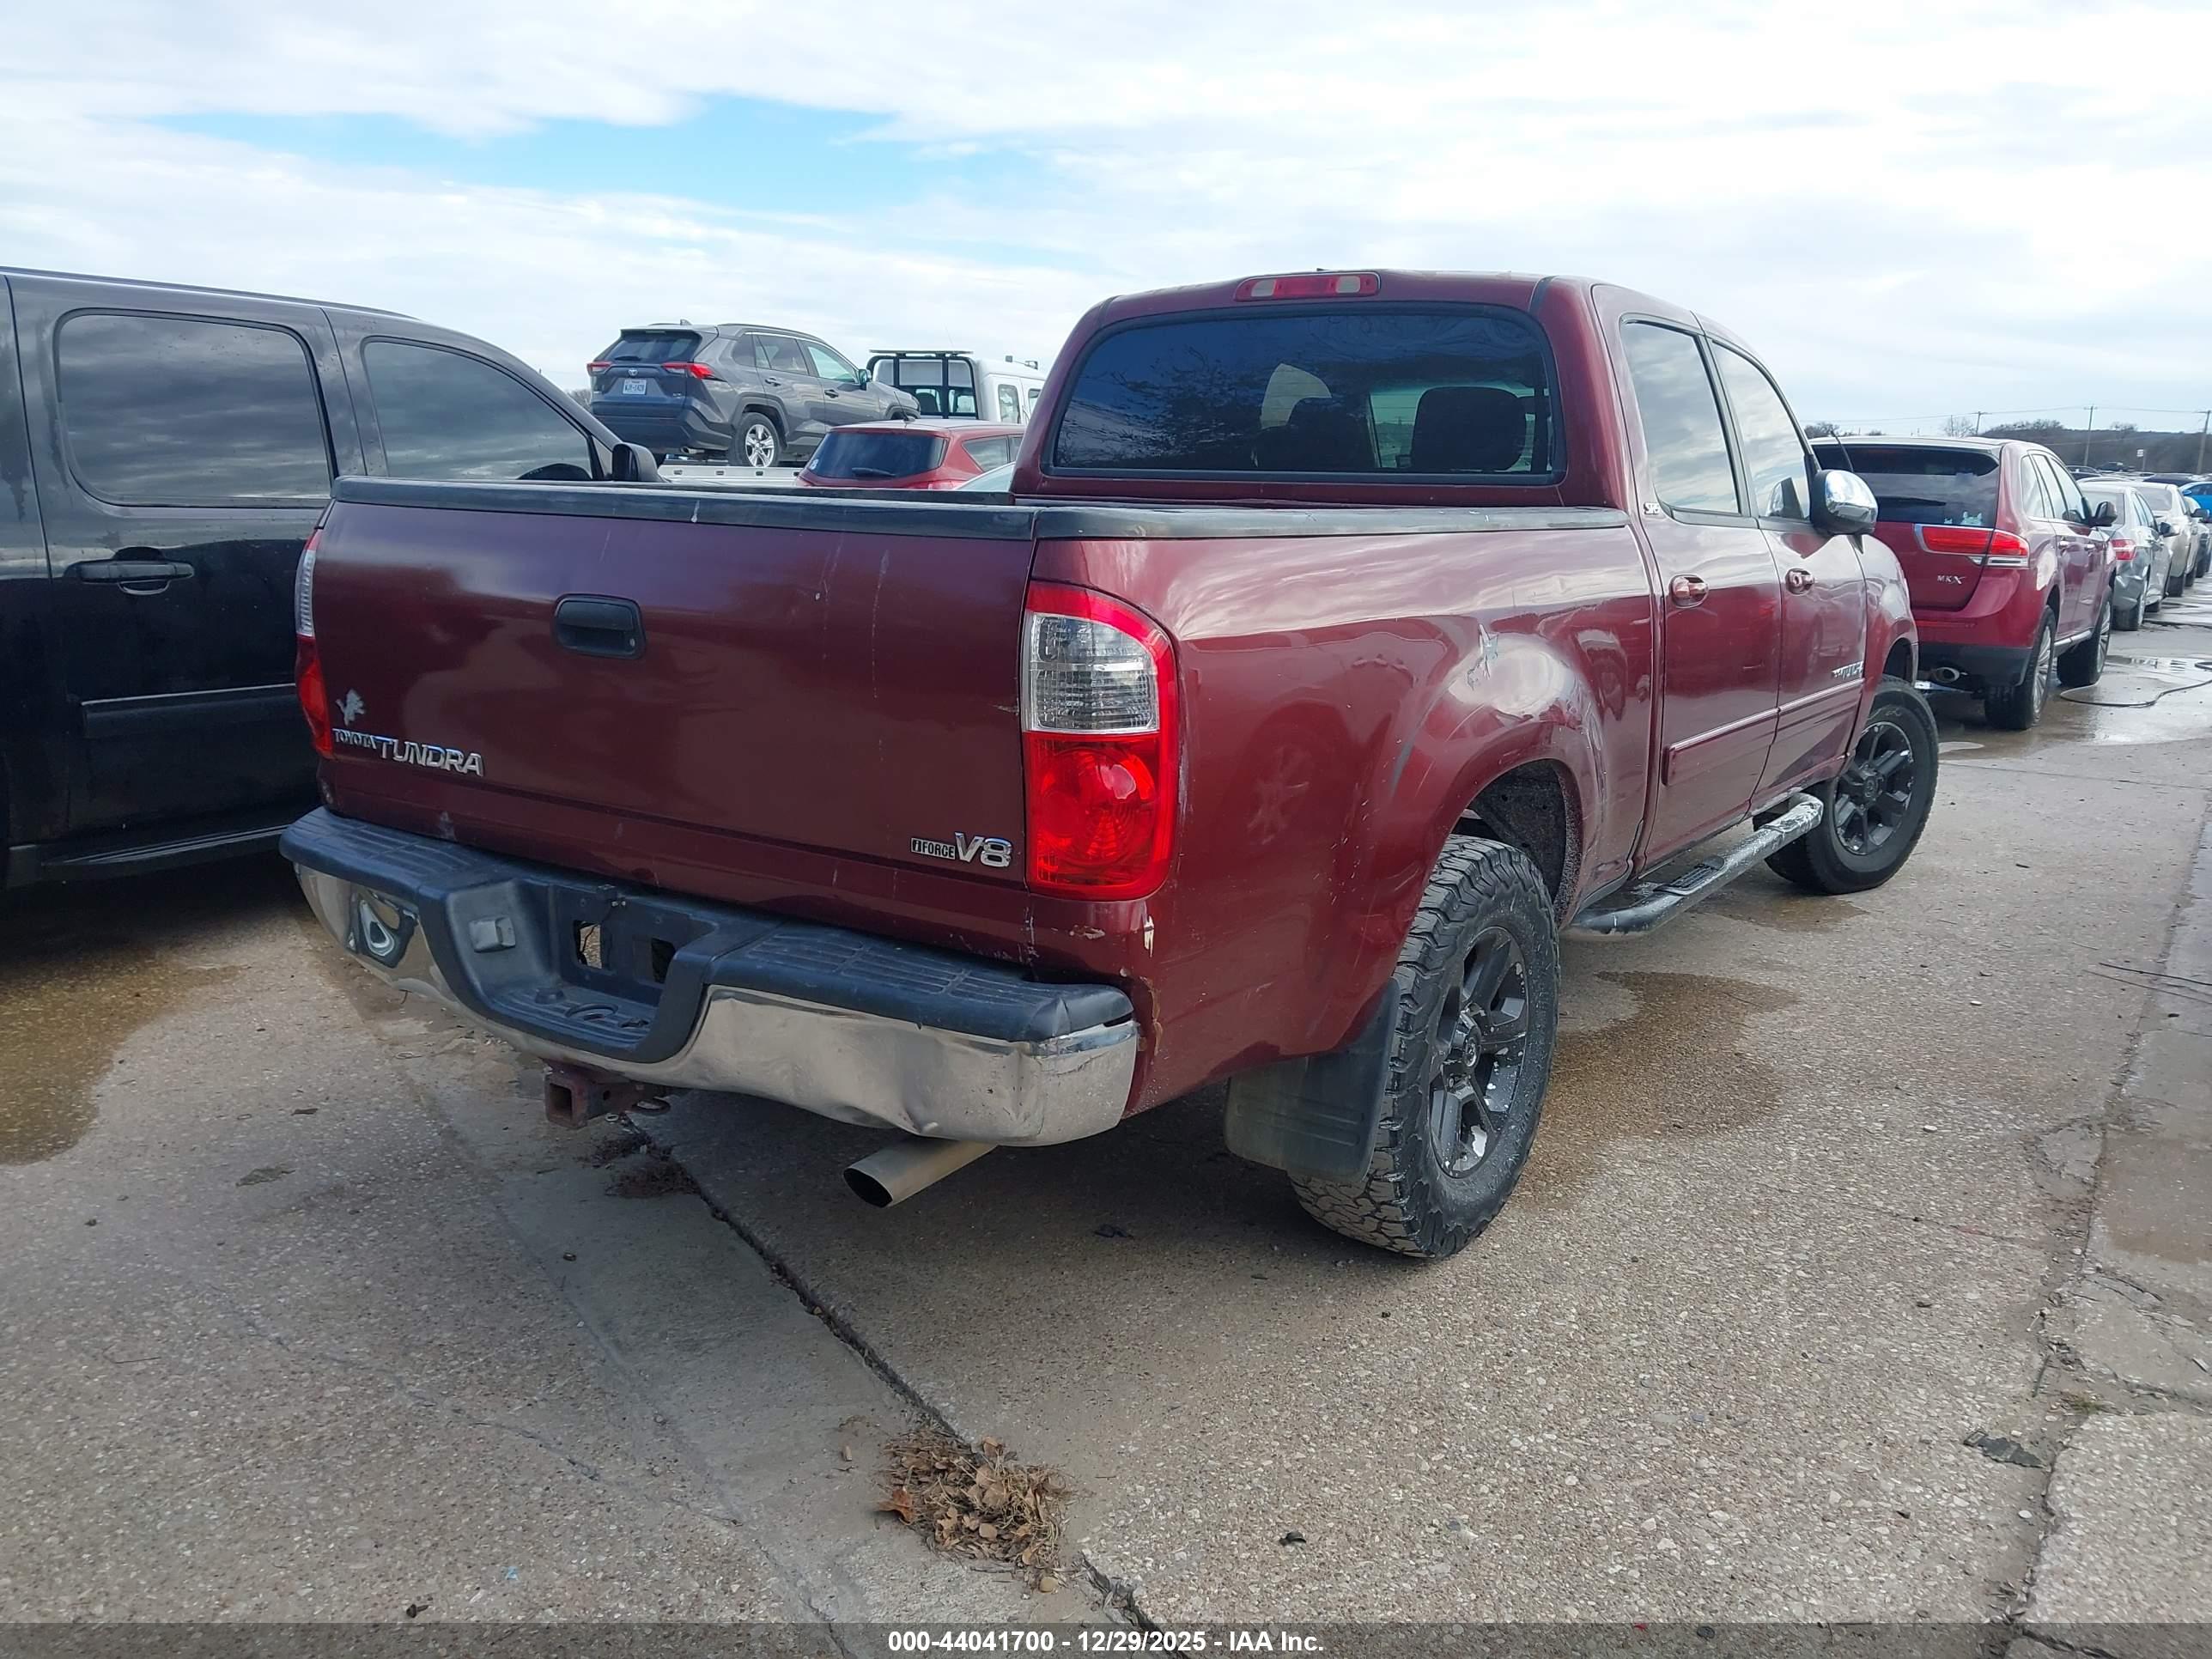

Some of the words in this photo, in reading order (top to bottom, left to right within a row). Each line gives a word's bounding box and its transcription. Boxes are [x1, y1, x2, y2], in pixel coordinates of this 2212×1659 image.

[1936, 574, 1966, 585] MKX
[331, 728, 376, 749] TOYOTA
[373, 735, 483, 776] TUNDRA
[955, 832, 1012, 867] V8
